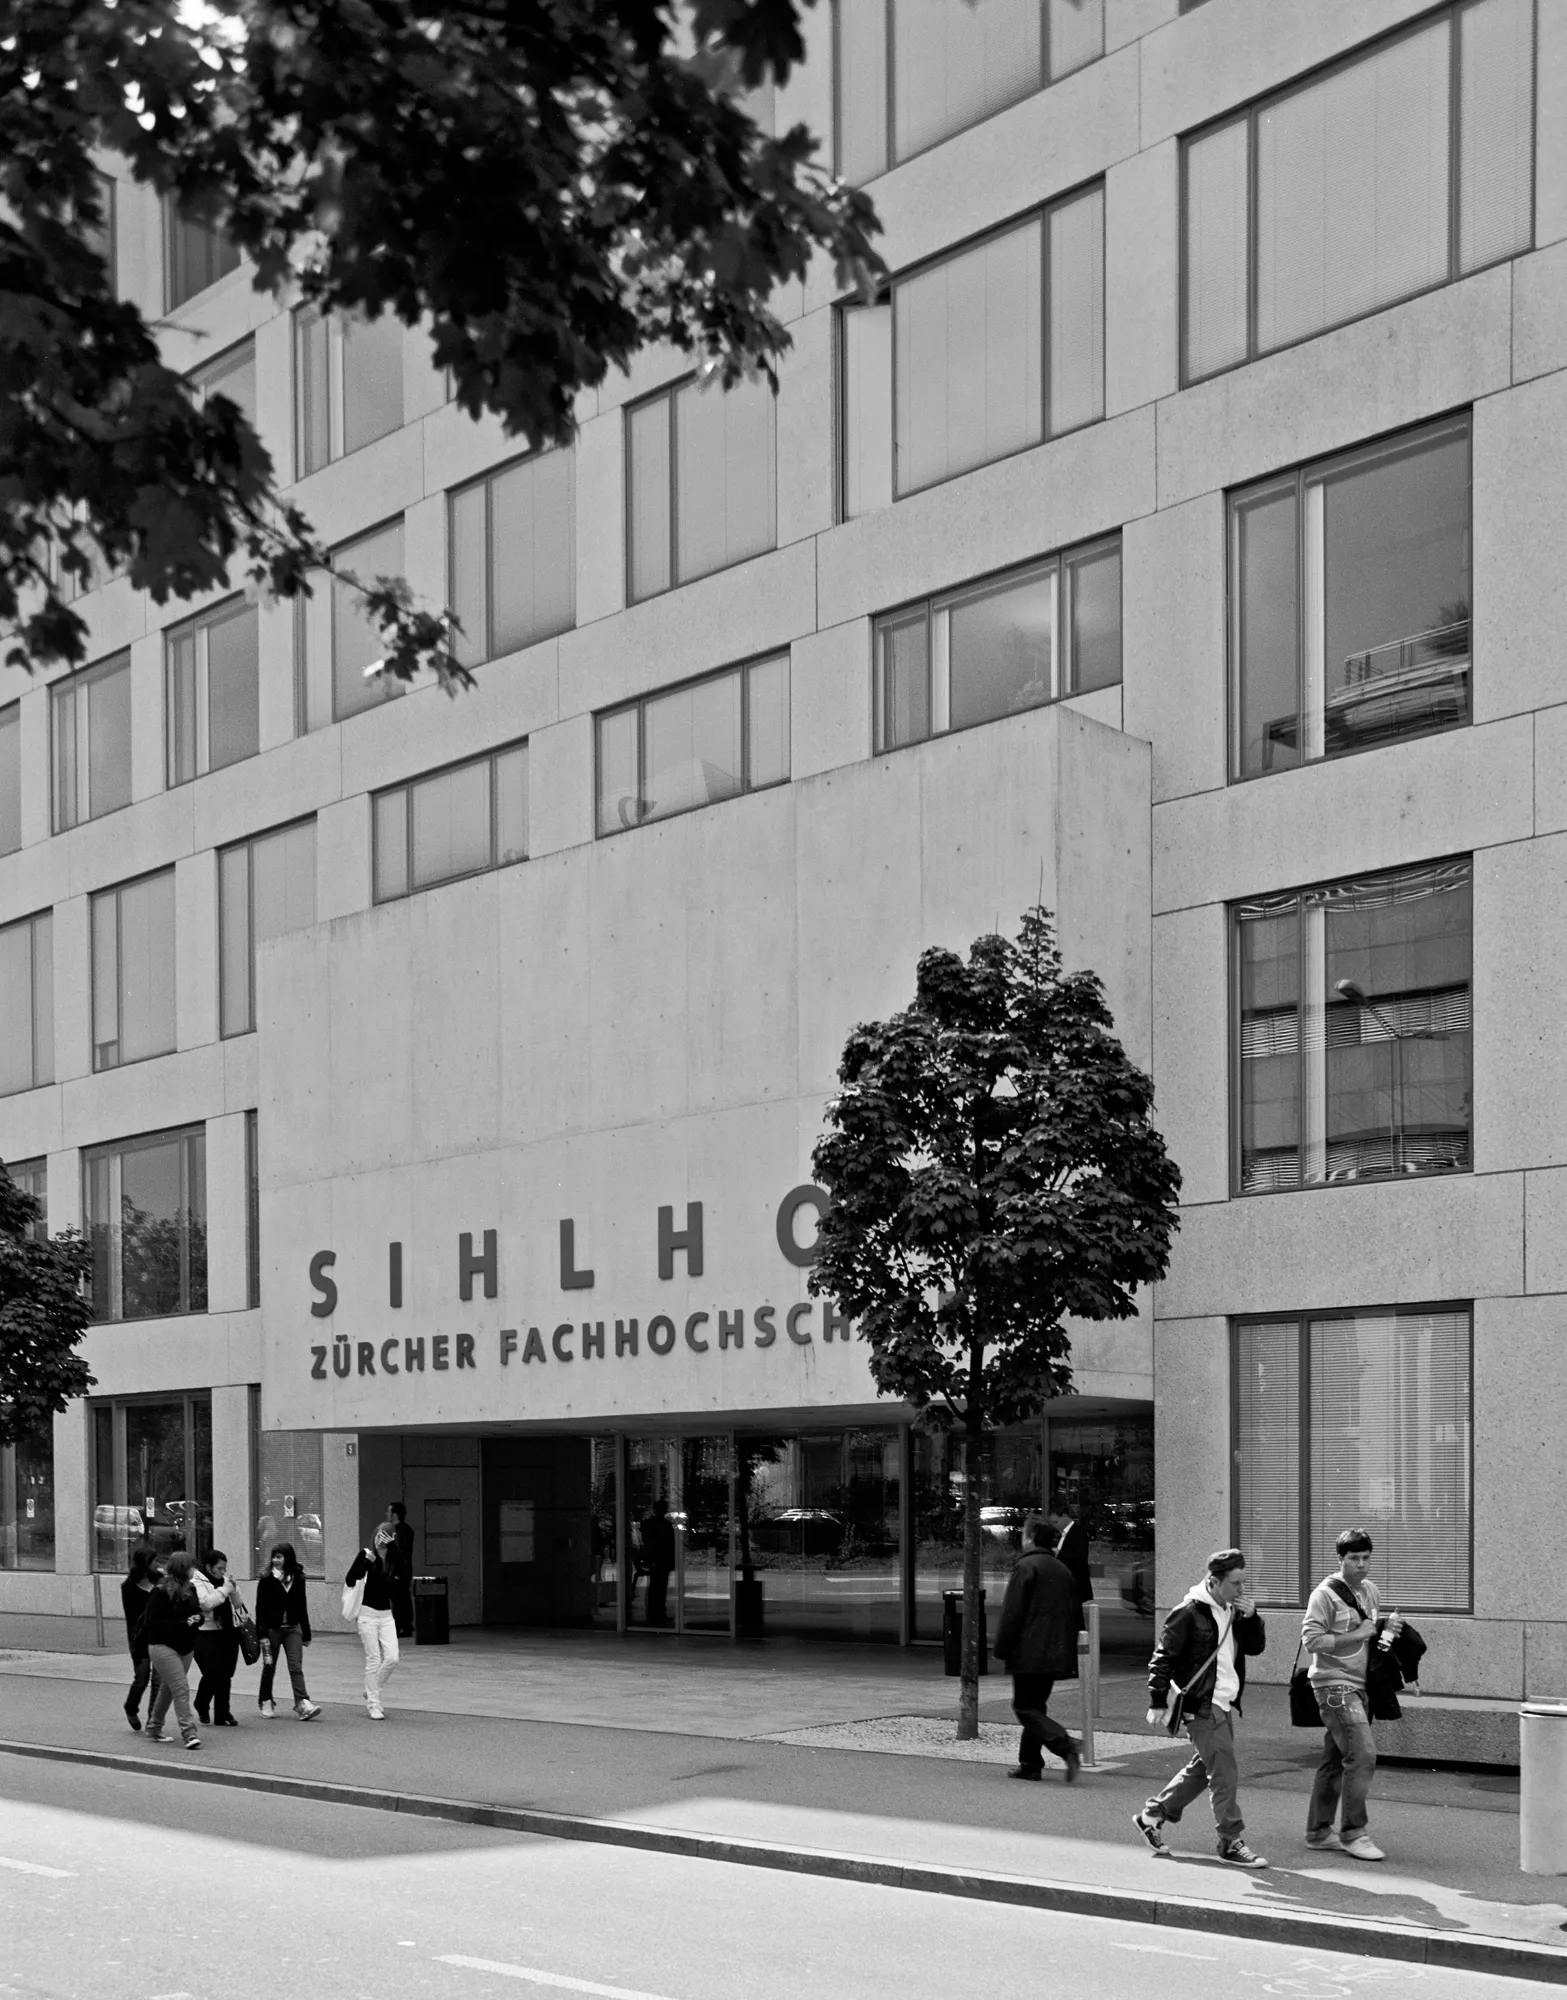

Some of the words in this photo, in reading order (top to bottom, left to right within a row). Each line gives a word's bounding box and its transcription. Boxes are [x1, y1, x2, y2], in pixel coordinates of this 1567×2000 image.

[309, 1184, 833, 1318] SIHLHO
[311, 1333, 477, 1380] ZÜRCHER
[499, 1301, 850, 1367] FACHHOCHSCH
